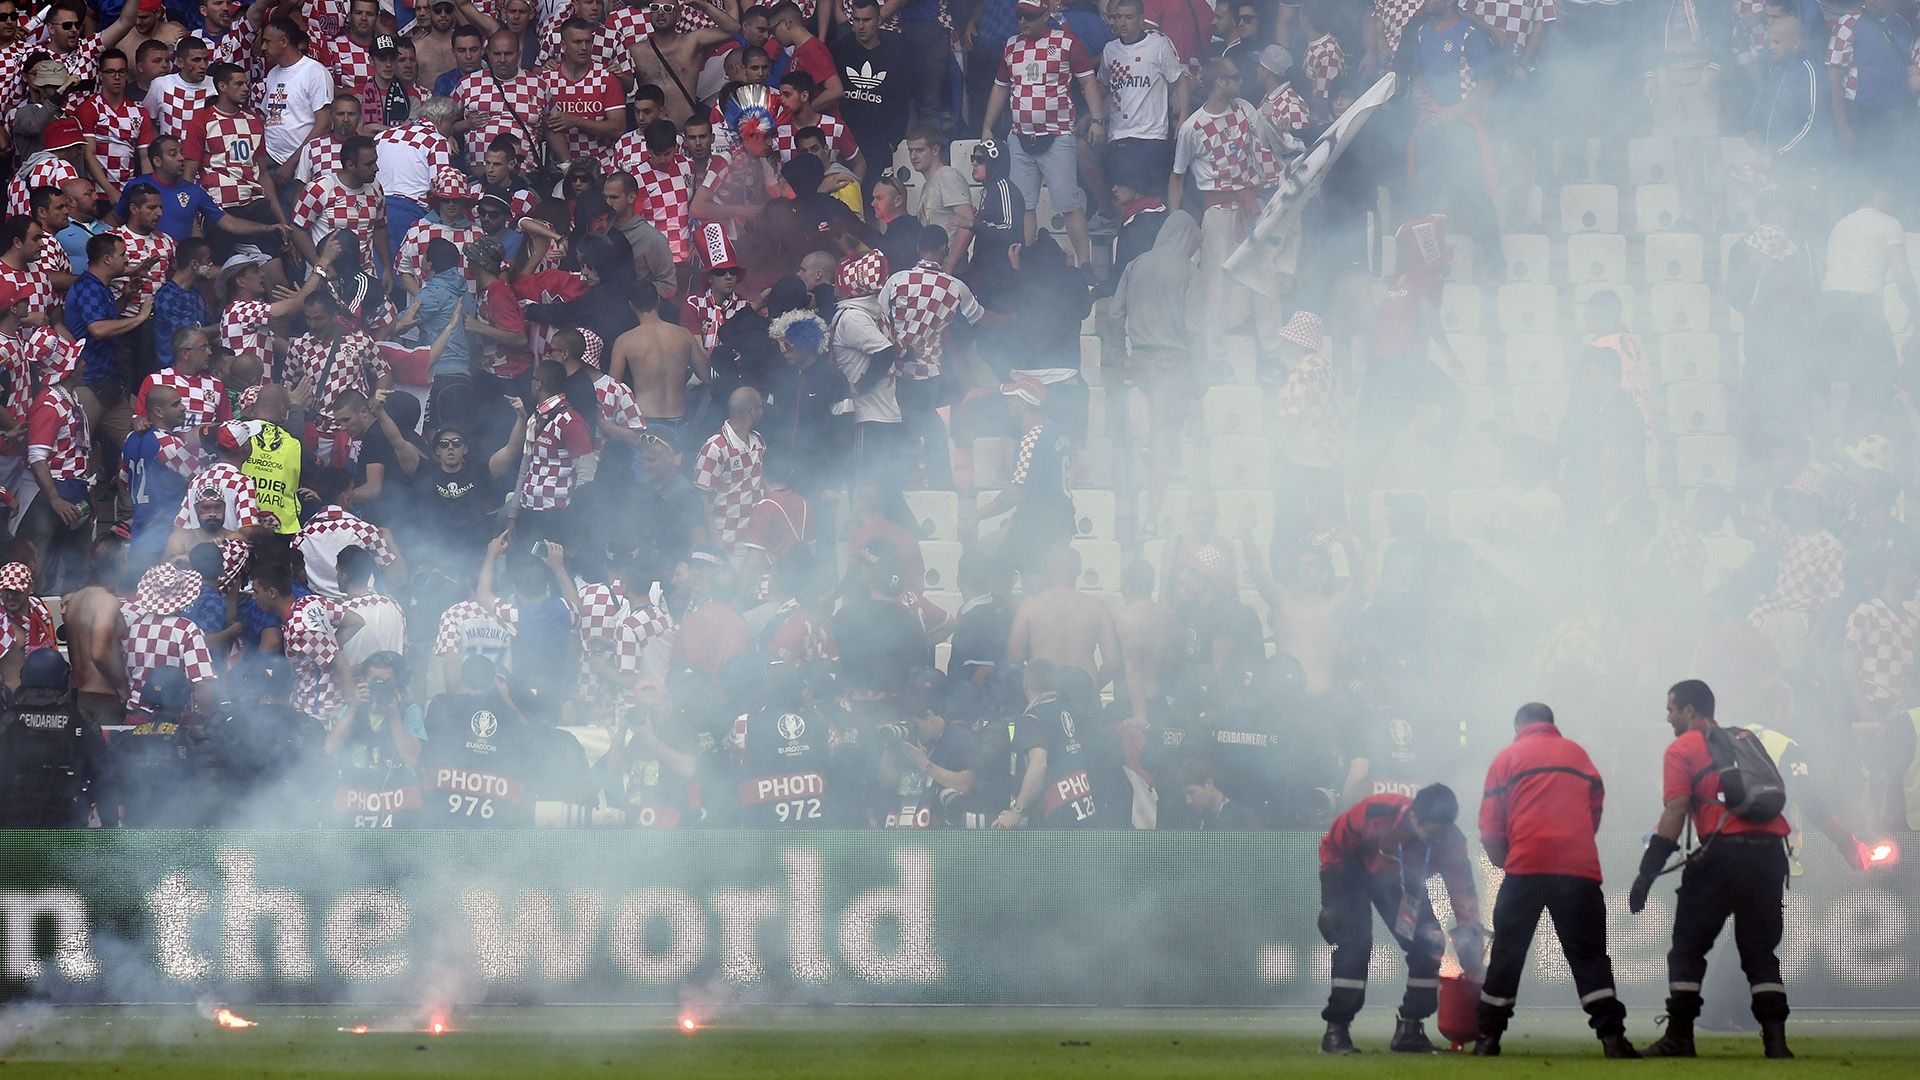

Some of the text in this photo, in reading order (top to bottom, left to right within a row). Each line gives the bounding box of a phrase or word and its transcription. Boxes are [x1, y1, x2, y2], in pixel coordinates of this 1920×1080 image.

[1025, 62, 1040, 81] 10
[844, 90, 882, 104] adidas
[230, 140, 250, 161] 10
[129, 458, 150, 504] 12
[437, 768, 508, 797] PHOTO
[347, 789, 404, 812] PHOTO
[448, 794, 495, 819] 976
[775, 798, 822, 823] 972
[147, 846, 411, 984] the
[462, 846, 947, 985] world
